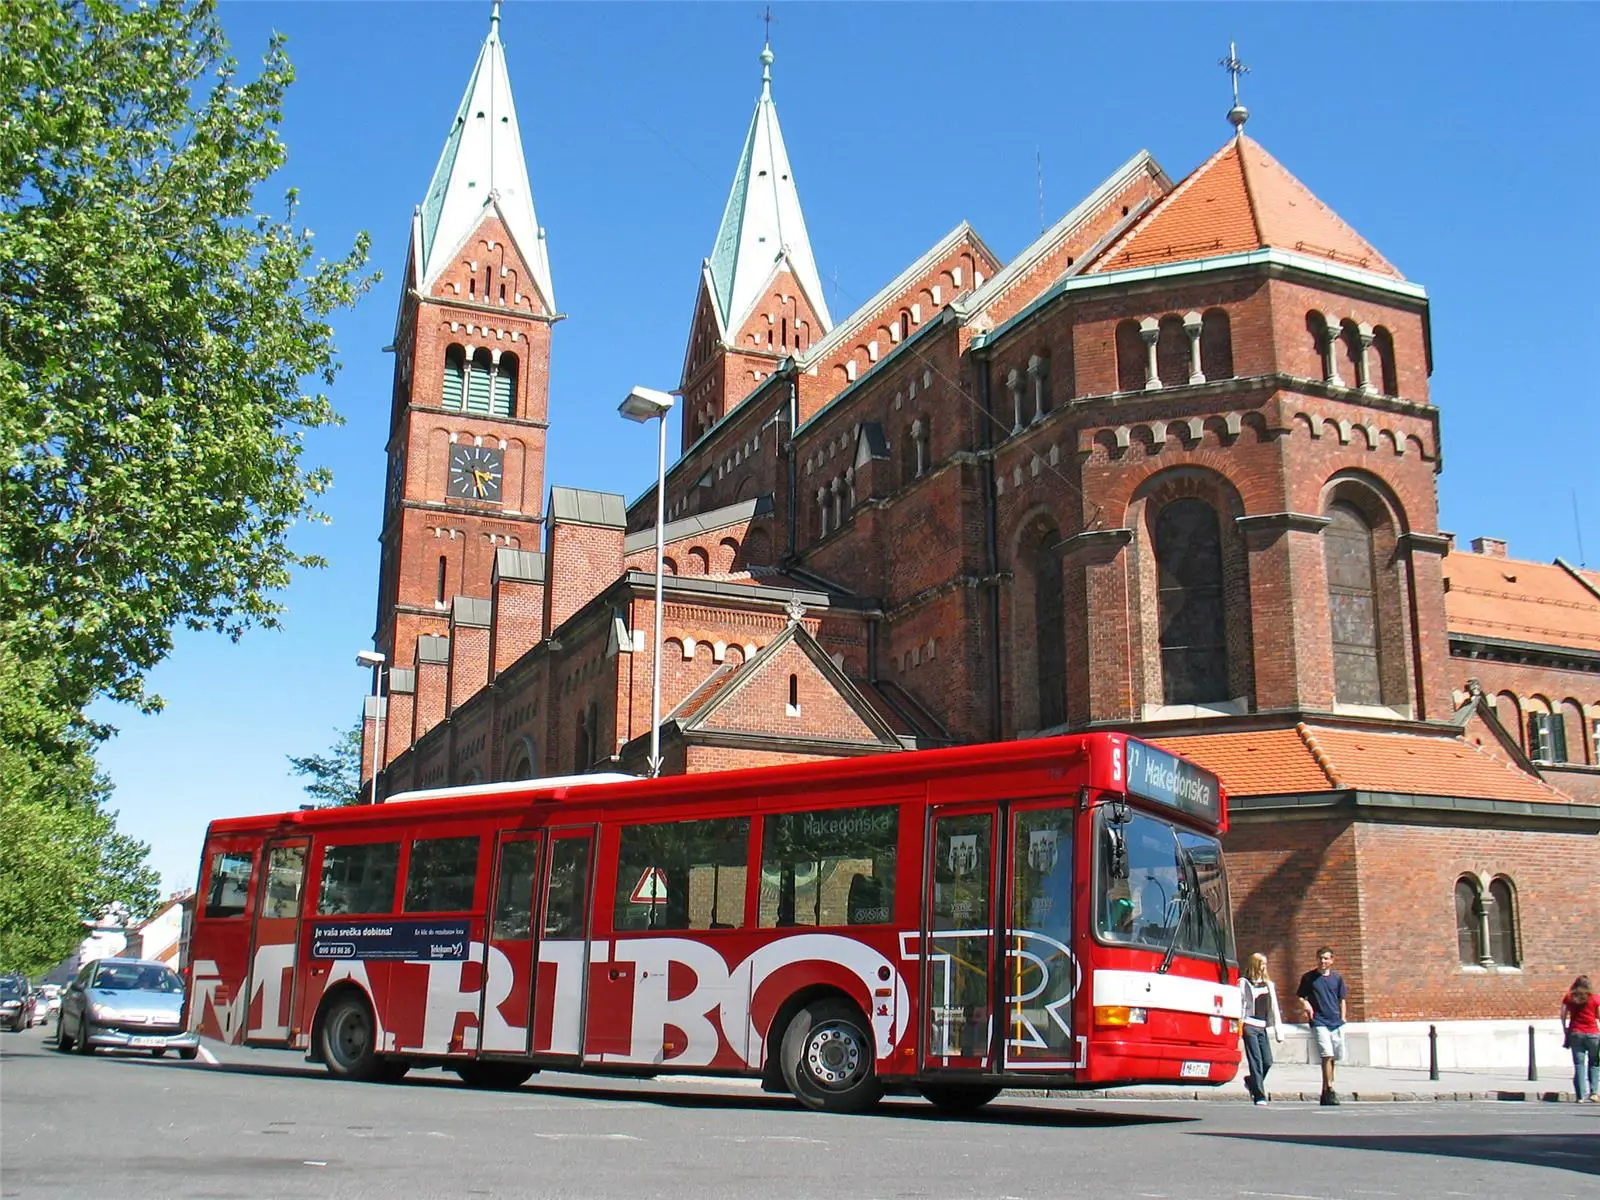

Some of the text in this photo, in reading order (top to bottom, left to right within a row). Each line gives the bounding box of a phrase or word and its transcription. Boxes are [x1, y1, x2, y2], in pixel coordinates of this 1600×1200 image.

[1113, 748, 1122, 781] S
[1145, 756, 1210, 806] Makedonska
[314, 926, 393, 939] Je vaša srečka dobitna!
